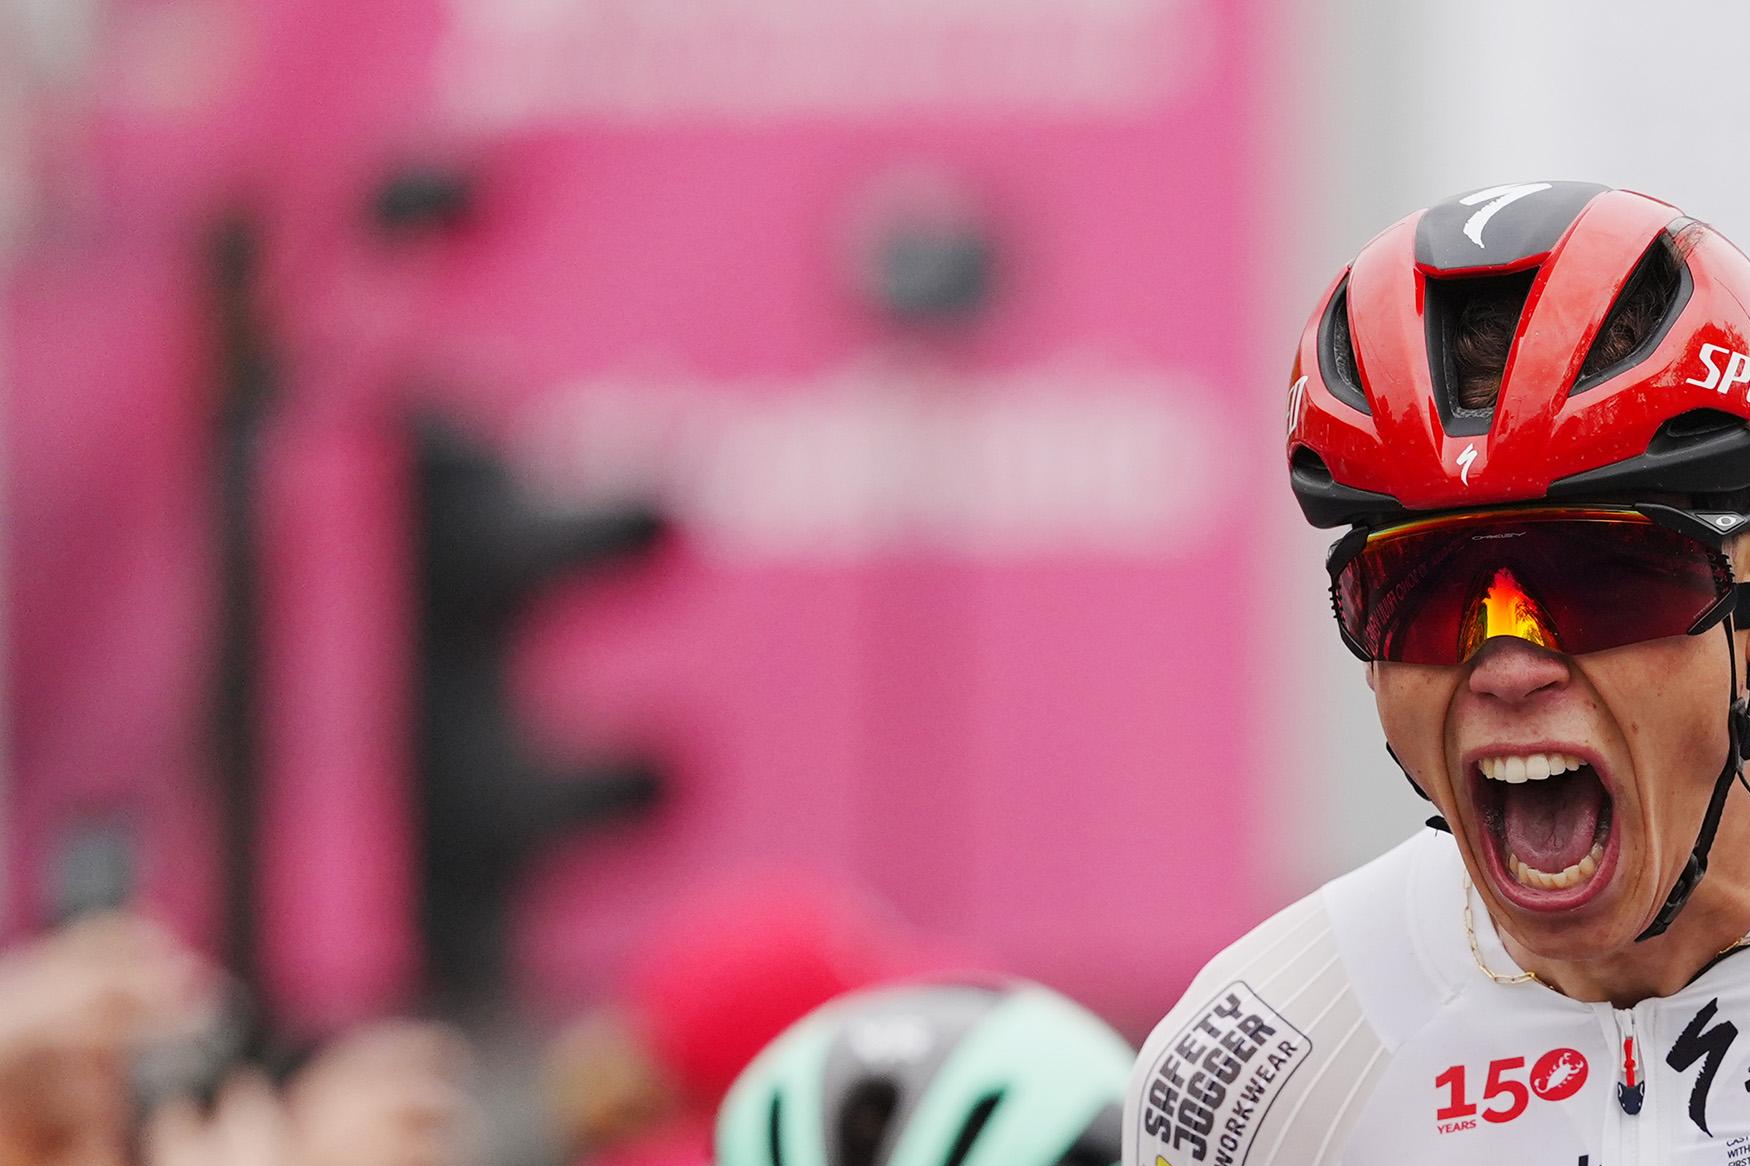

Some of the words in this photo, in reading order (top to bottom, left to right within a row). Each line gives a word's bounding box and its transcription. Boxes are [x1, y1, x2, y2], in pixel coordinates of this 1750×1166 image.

[1145, 993, 1243, 1144] SAFETY
[1173, 1014, 1276, 1161] JOGGER
[1438, 1120, 1477, 1134] YEARS
[1727, 1145, 1750, 1158] WITH
